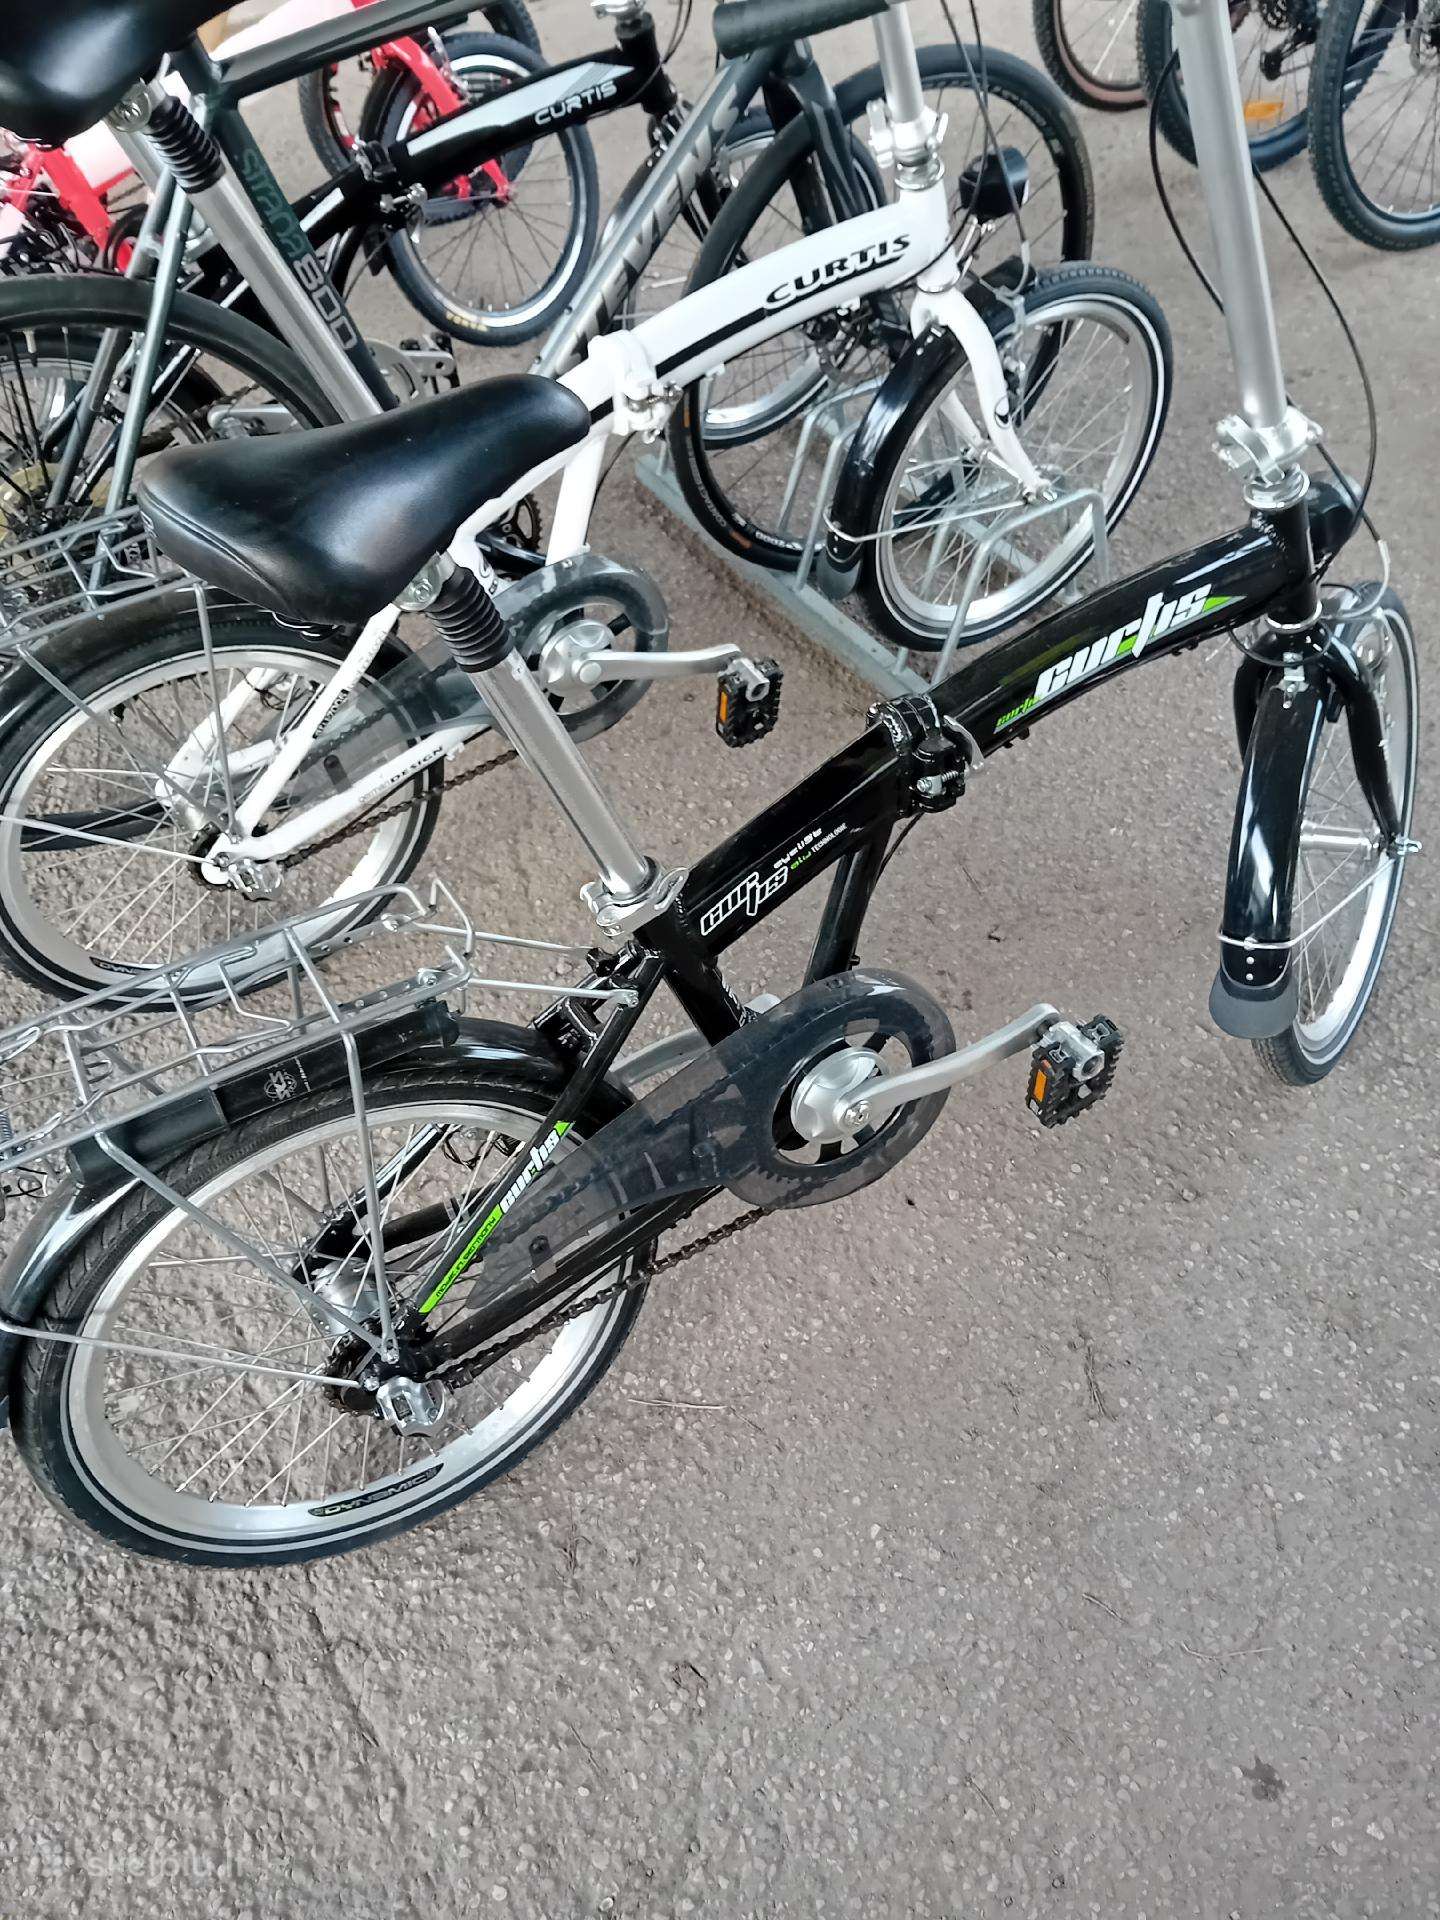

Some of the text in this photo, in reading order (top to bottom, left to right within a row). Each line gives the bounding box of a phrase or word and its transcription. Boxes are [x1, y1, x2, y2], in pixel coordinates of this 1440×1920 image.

[534, 80, 618, 125] CURTIS
[555, 82, 740, 376] STEVENS
[766, 234, 911, 303] CURTIS
[292, 253, 359, 350] 800
[1033, 584, 1213, 700] curtis
